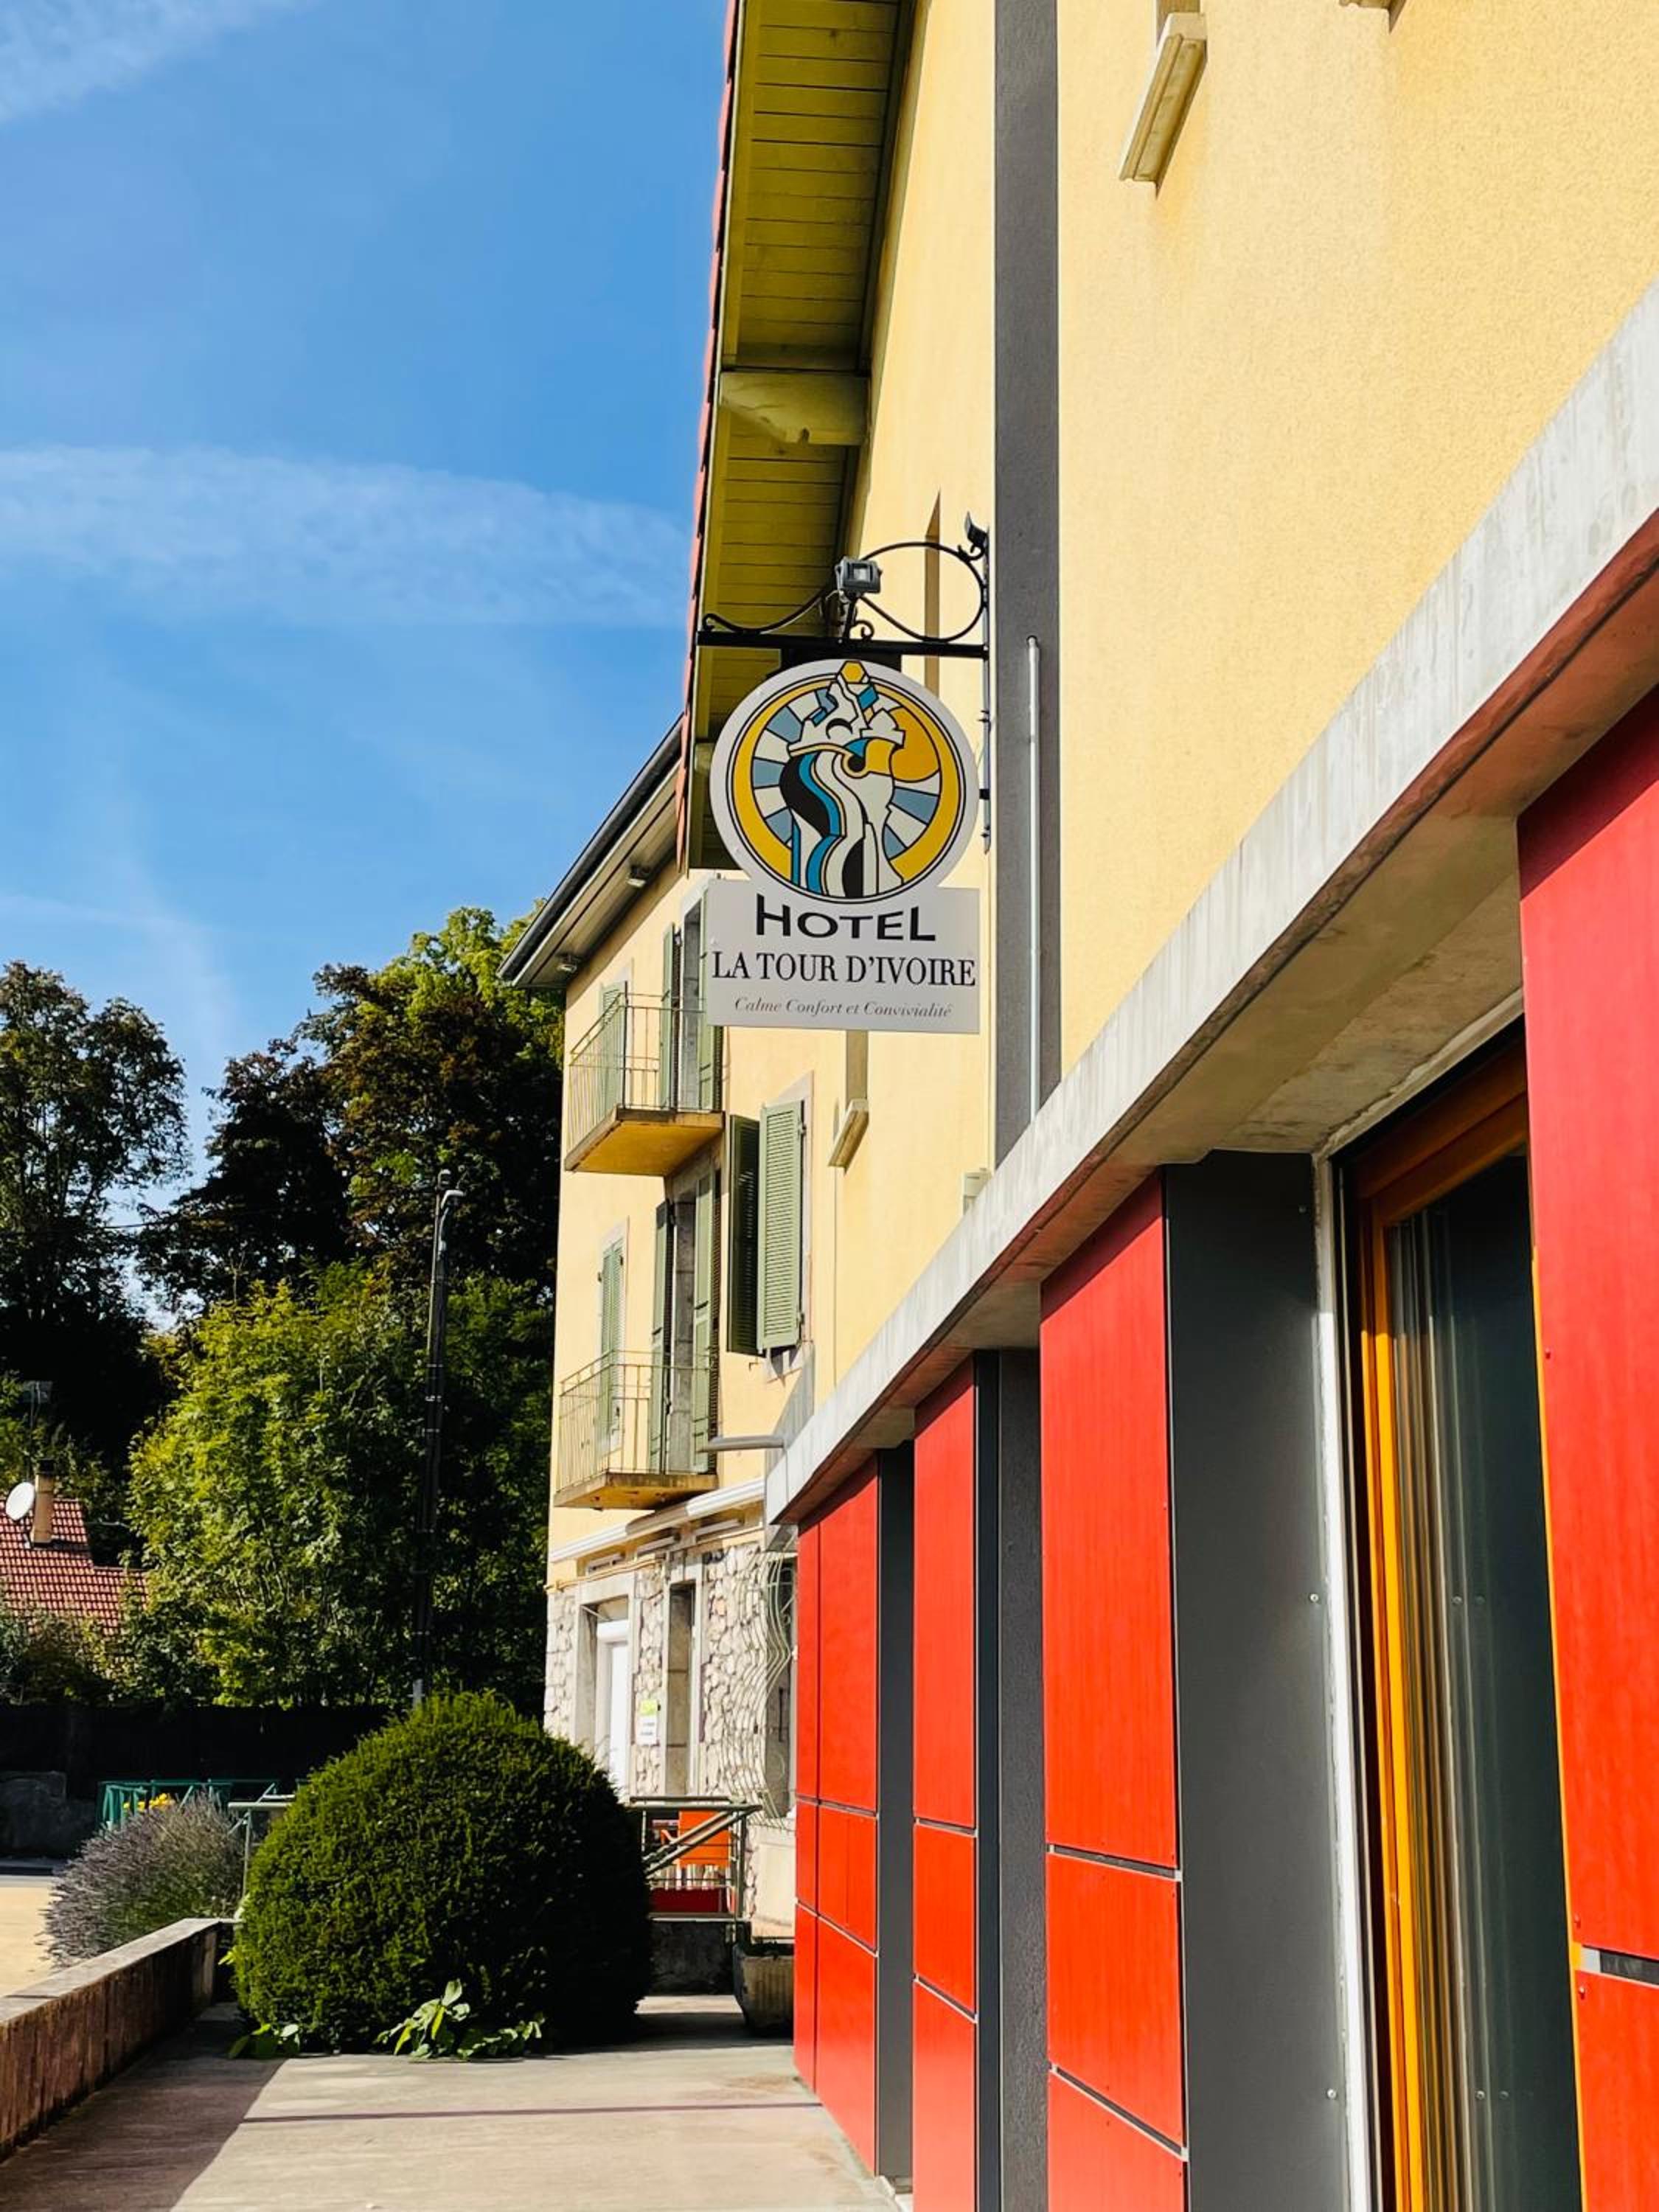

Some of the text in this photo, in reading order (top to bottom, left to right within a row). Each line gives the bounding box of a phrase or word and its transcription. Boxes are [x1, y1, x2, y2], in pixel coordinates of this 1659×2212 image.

[757, 893, 936, 942] HOTEL
[712, 951, 975, 986] LA TOUR D'IVOIRE
[735, 997, 953, 1018] Calme Confort et Convivialité
